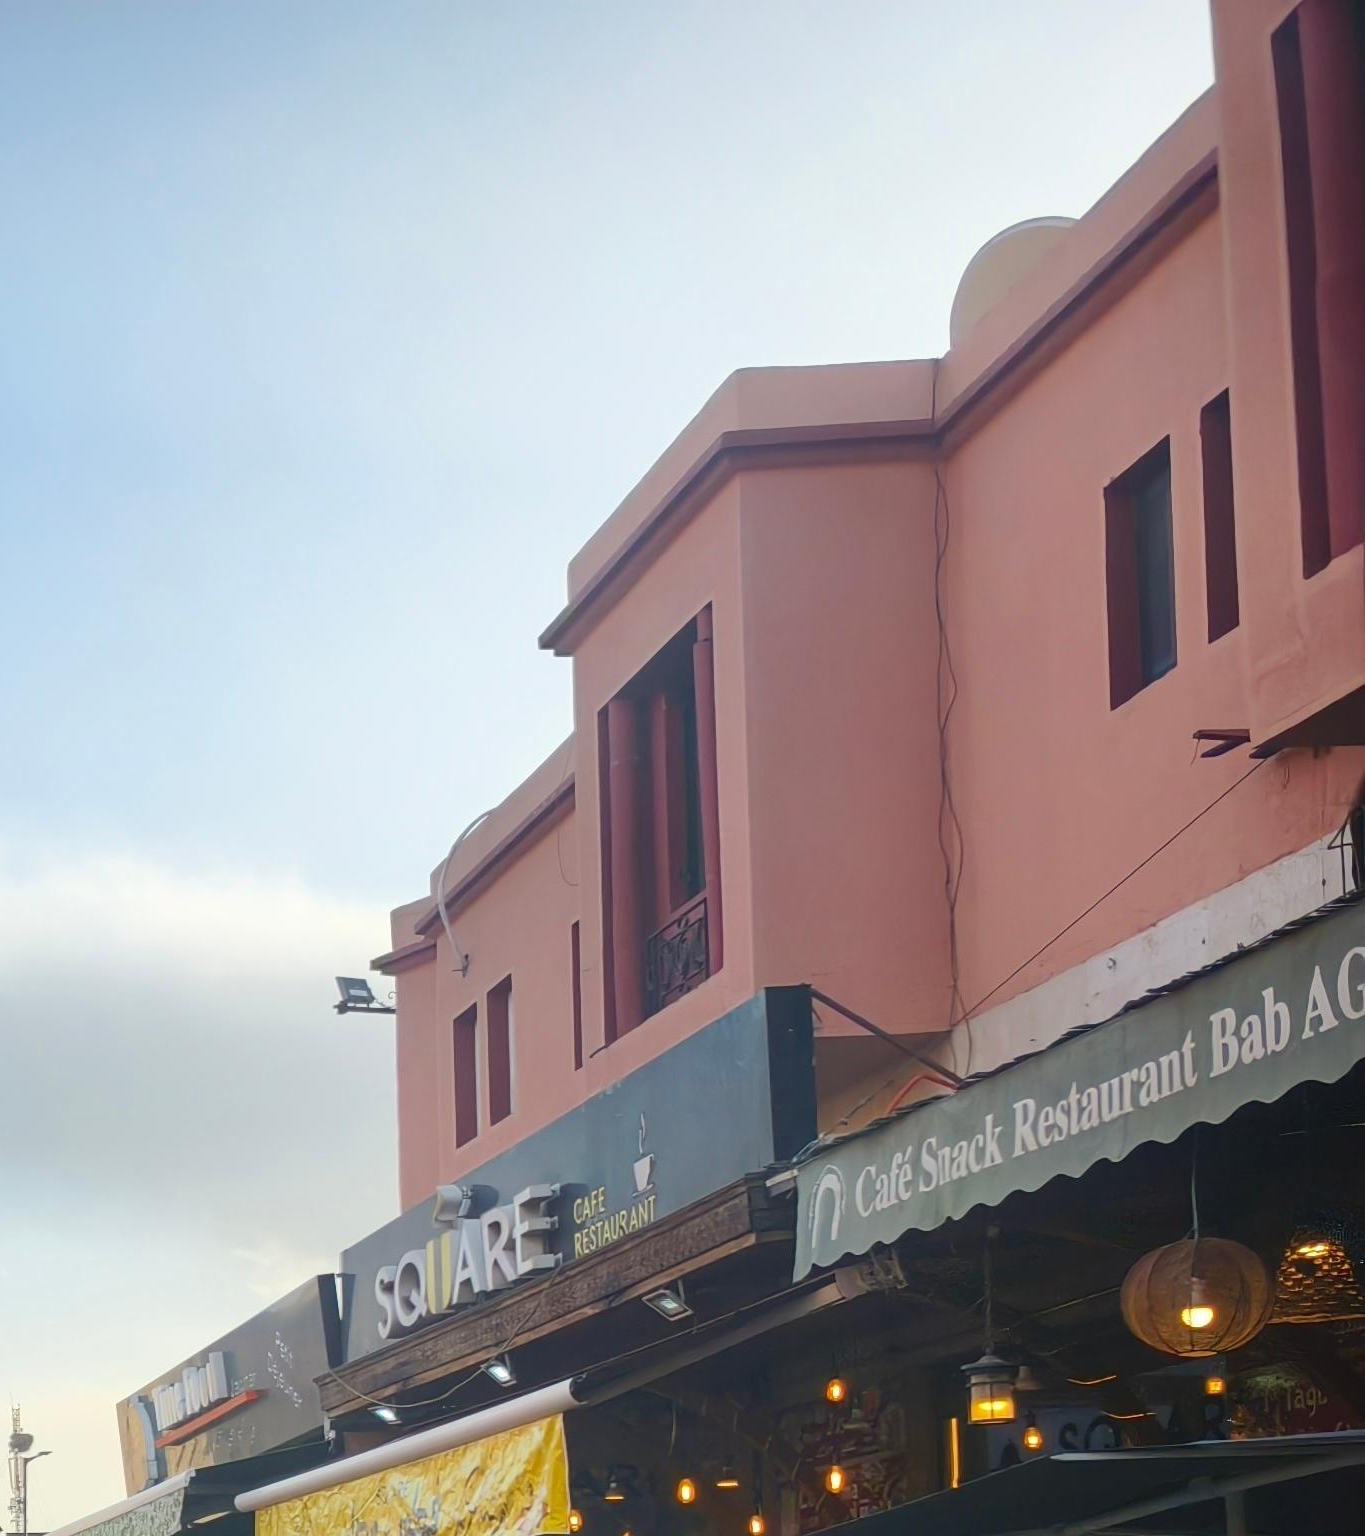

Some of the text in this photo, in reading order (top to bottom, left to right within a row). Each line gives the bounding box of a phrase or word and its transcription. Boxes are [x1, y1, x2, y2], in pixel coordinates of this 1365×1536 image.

[855, 1144, 913, 1218] Café
[919, 1113, 1004, 1192] Snack
[1012, 1029, 1198, 1159] Restaurant
[1209, 986, 1291, 1079] Bab
[573, 1186, 606, 1225] CAFE
[574, 1194, 657, 1259] RESTAURANT
[374, 1183, 563, 1340] SQUARE
